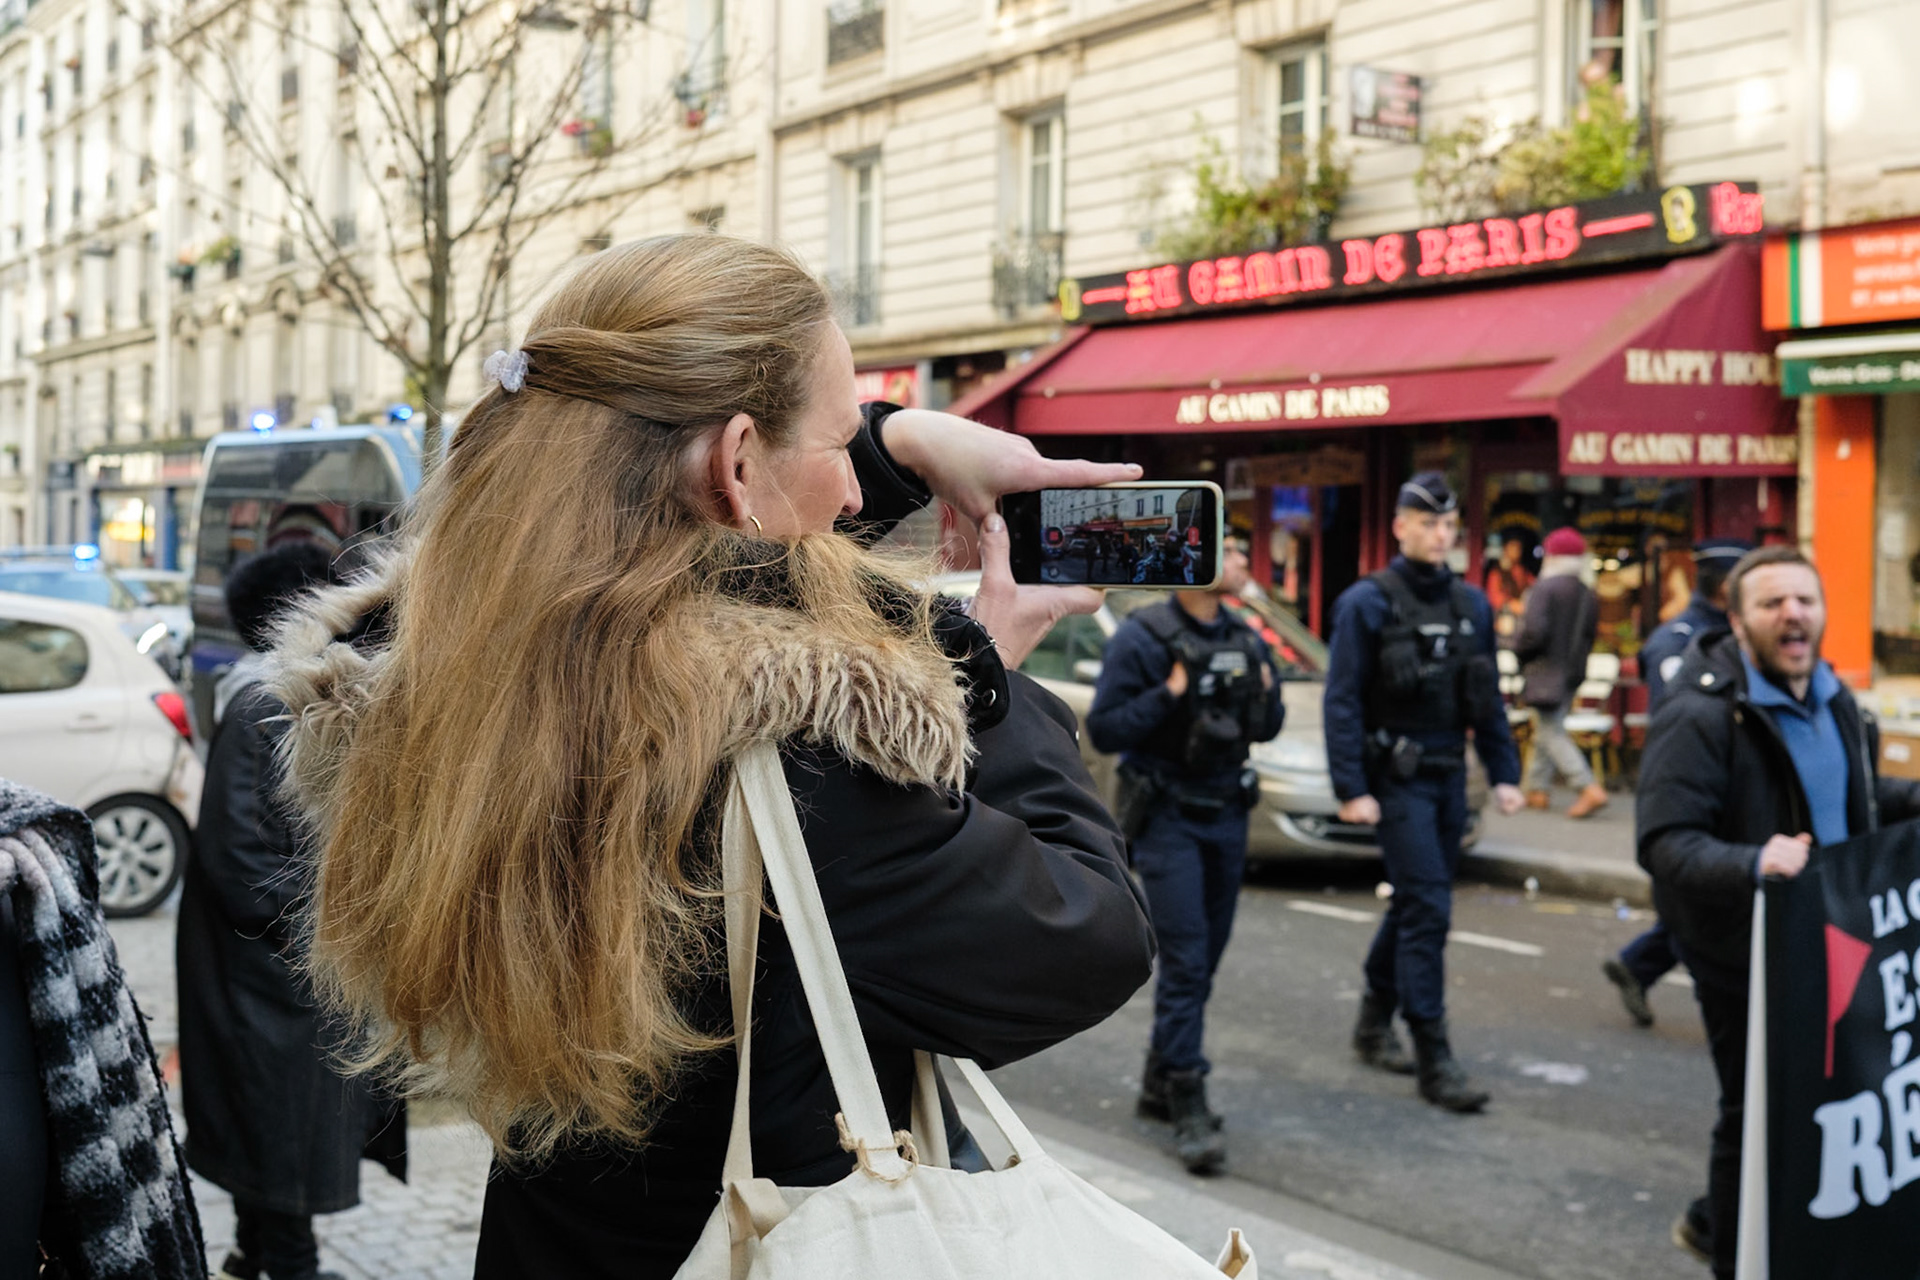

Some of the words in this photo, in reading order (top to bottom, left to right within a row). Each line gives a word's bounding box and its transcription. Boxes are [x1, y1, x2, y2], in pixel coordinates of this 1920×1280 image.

[1416, 206, 1580, 276] PARIS
[1625, 349, 1716, 385] HAPPY
[1176, 394, 1207, 424] AU
[1208, 391, 1281, 423] GAMIN
[1284, 389, 1319, 419] DE
[1321, 384, 1390, 418] PARIS
[1568, 432, 1607, 464] AU
[1611, 433, 1694, 465] GAMIN
[1698, 434, 1733, 465] DE
[1869, 887, 1909, 939] LA
